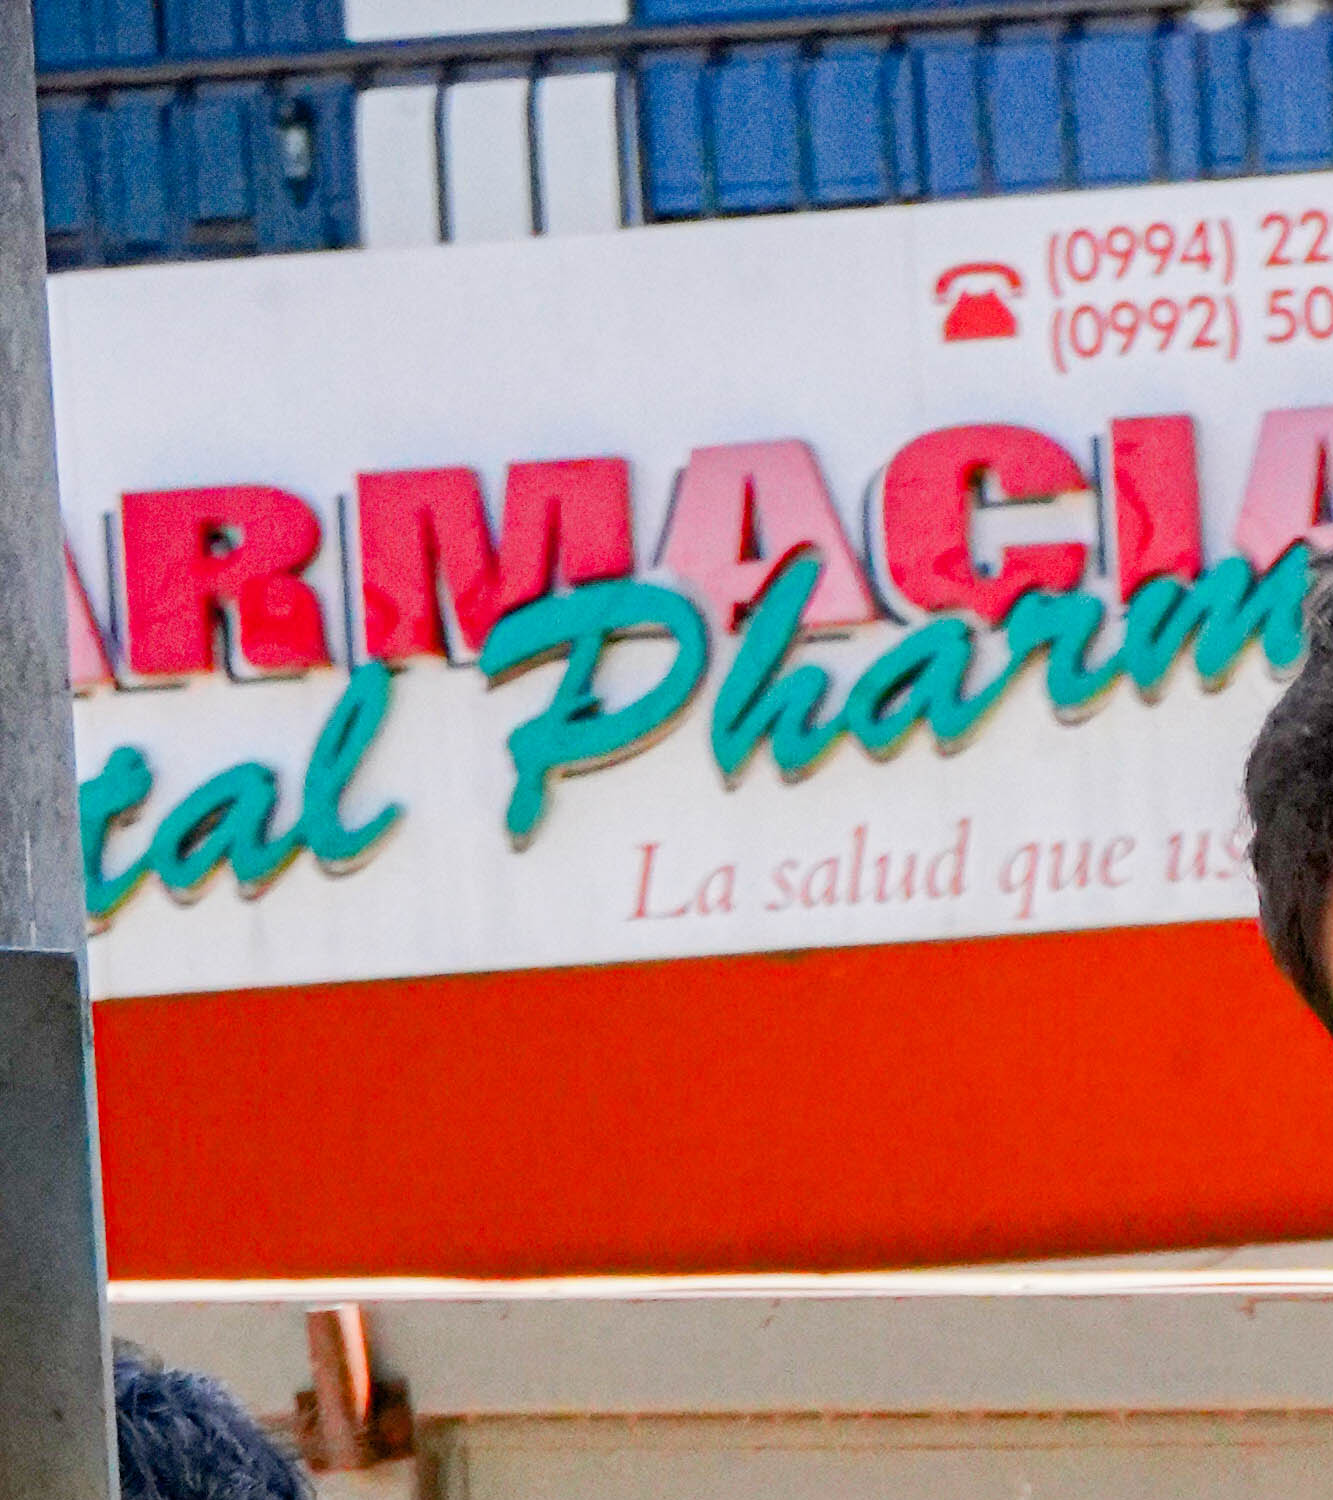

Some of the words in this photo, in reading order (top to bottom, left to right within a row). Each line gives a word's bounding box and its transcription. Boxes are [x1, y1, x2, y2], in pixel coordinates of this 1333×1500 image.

[1047, 218, 1236, 299] (0994)
[1050, 294, 1240, 375] (0992)
[624, 841, 737, 921] La
[766, 817, 970, 916] salud
[999, 835, 1133, 922] que
